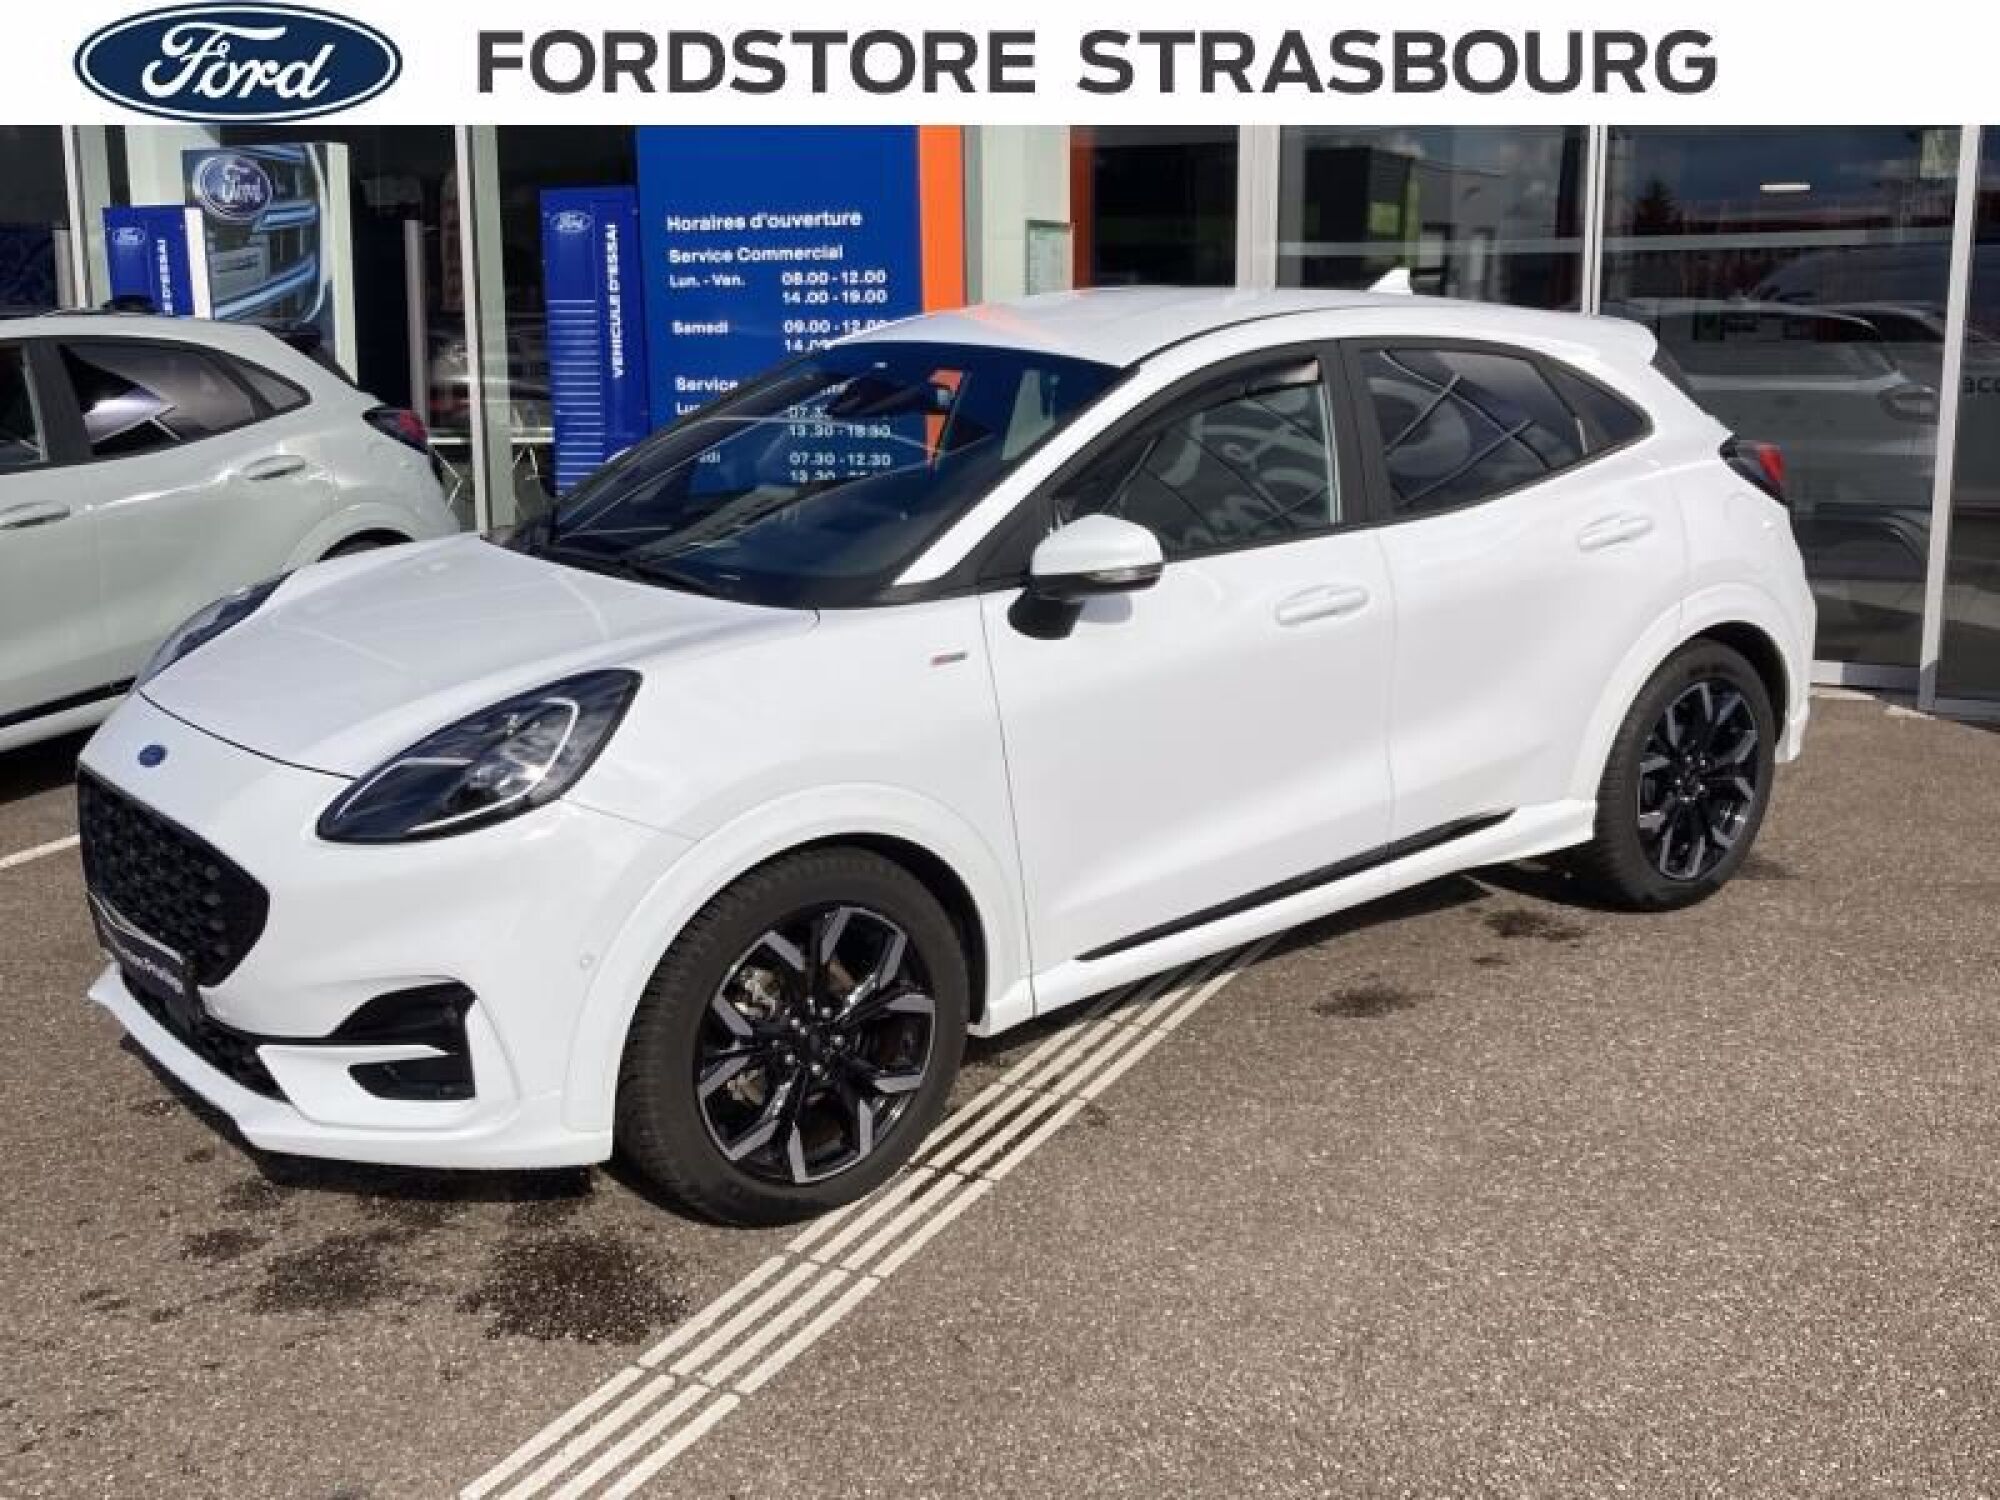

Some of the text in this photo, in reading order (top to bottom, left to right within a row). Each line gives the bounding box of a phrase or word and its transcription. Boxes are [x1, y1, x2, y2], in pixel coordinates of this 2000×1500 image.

[666, 211, 863, 231] Horaires d'ouverture
[669, 245, 844, 263] Service Commercial
[841, 269, 887, 284] 12.00
[672, 320, 729, 335] Samedi
[675, 376, 739, 392] Service
